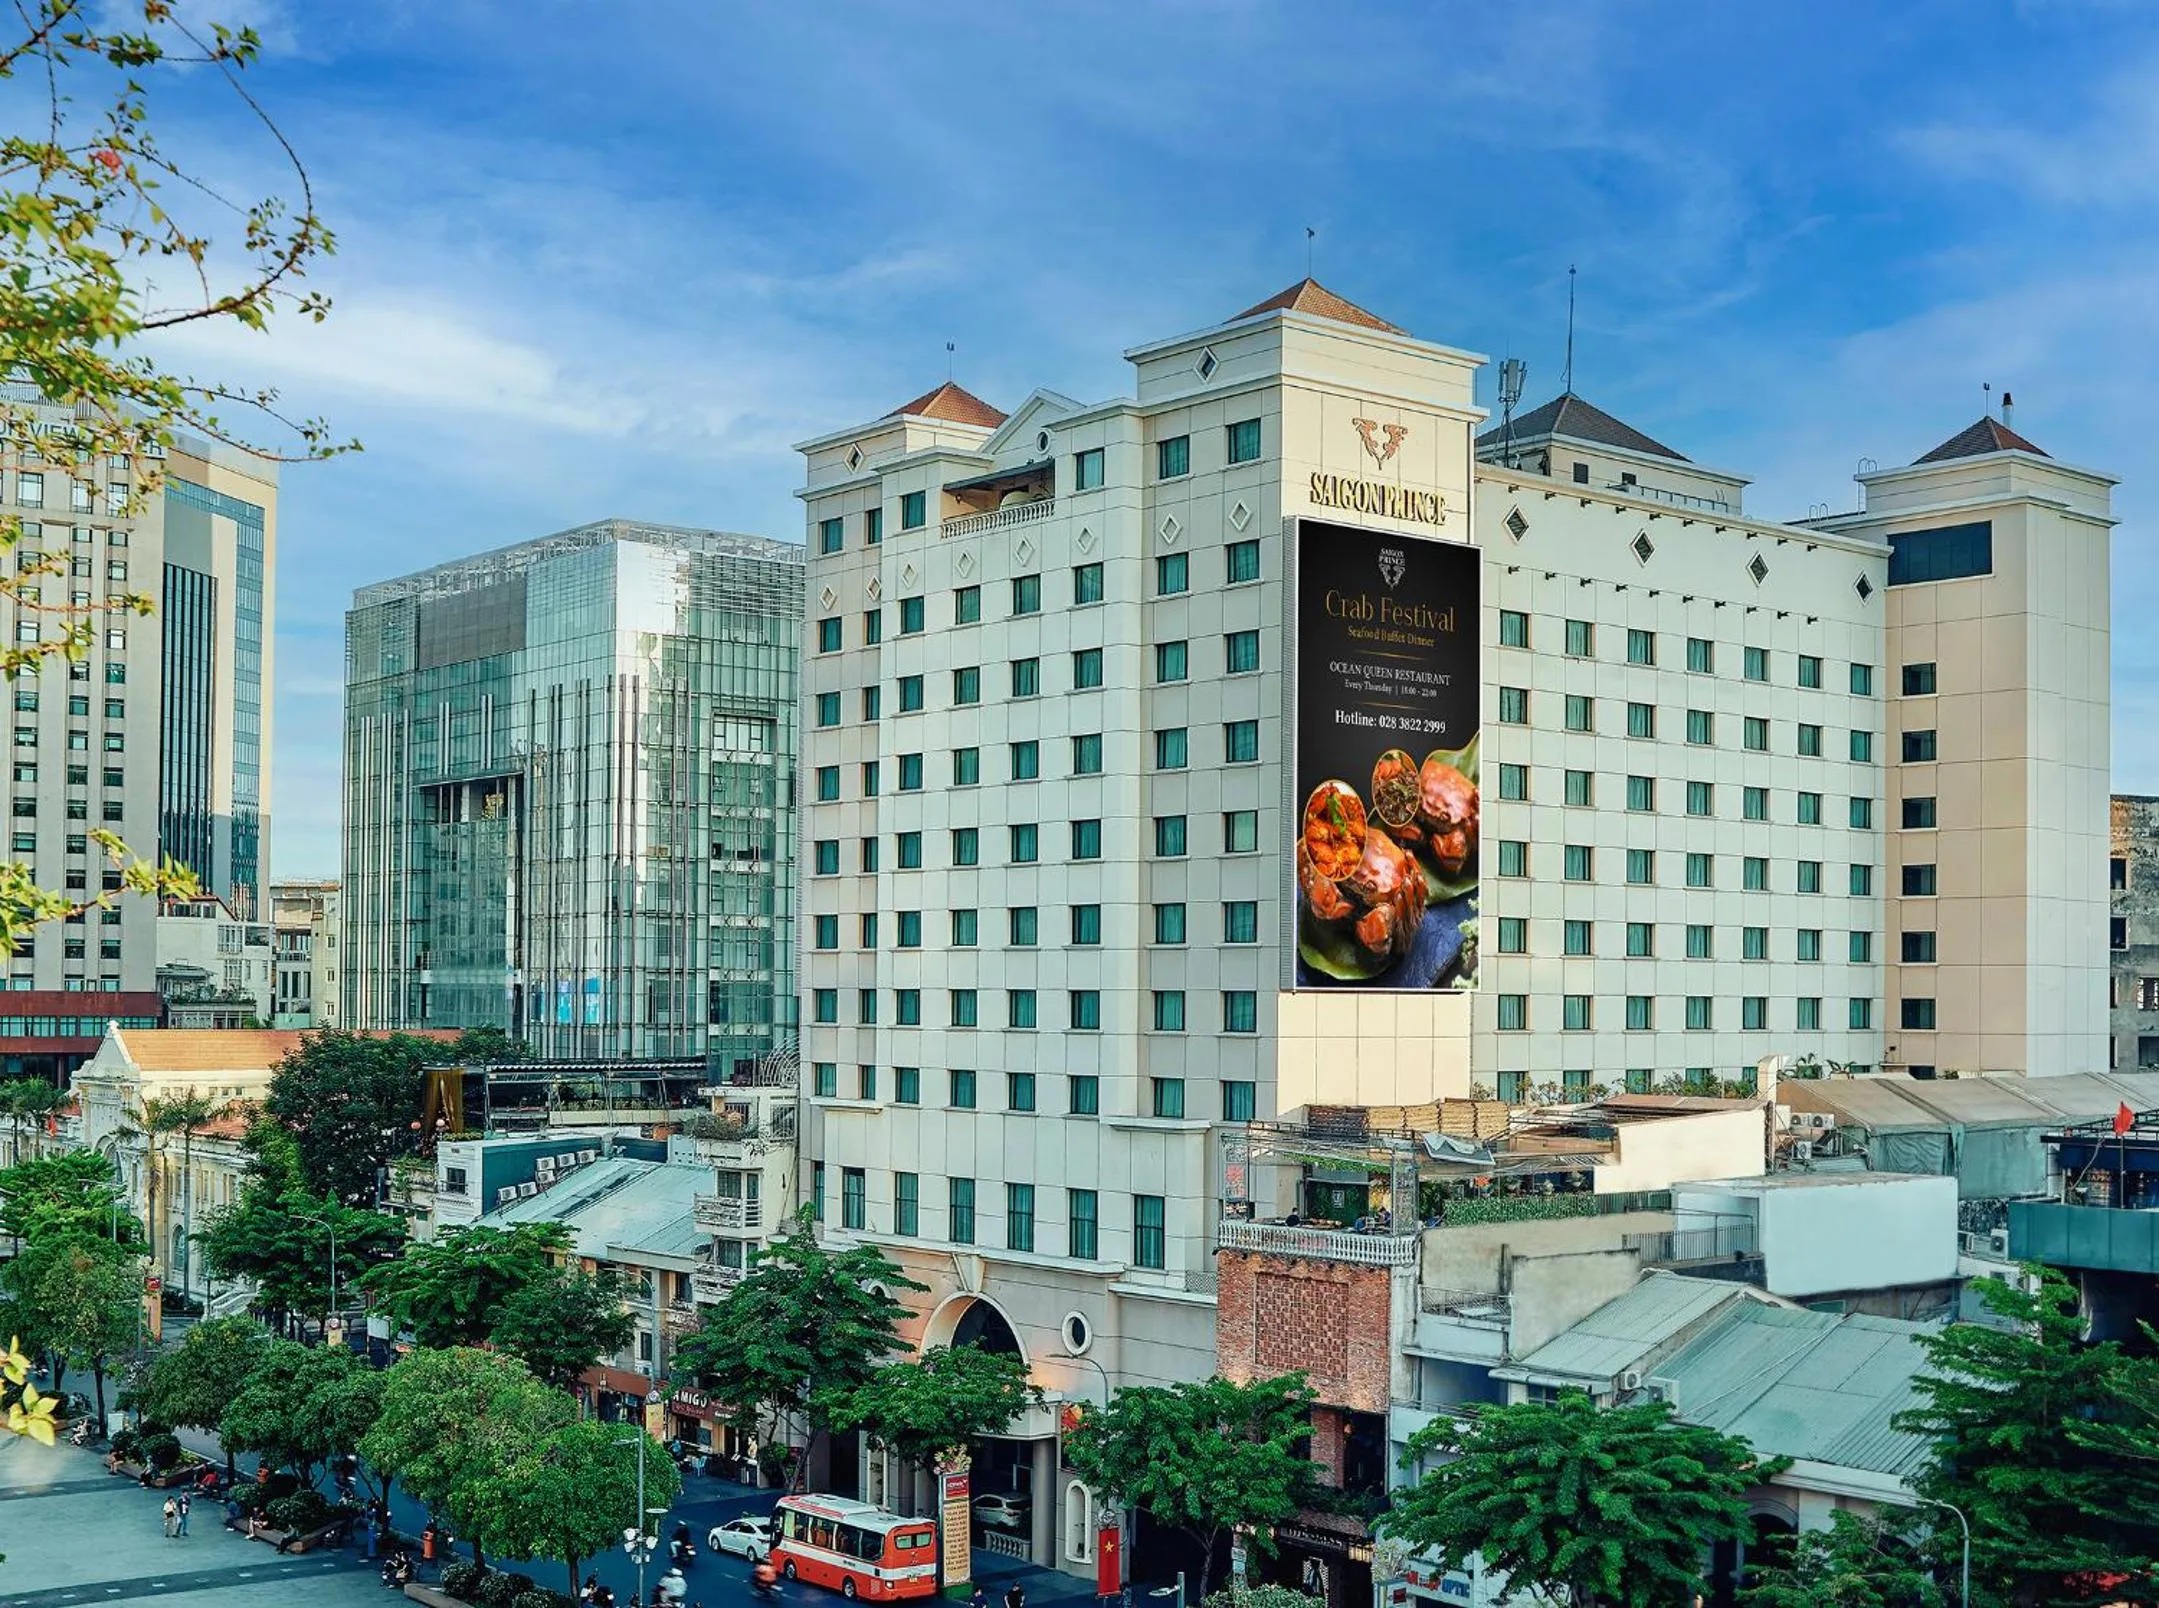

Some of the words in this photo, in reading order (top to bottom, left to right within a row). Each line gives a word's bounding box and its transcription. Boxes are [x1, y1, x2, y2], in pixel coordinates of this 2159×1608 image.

[1310, 472, 1381, 514] SAIGON
[1380, 484, 1446, 526] PRINCE
[1378, 556, 1406, 566] PRINCE
[1326, 589, 1374, 622] Crab
[1381, 597, 1455, 633] Festival
[1348, 625, 1380, 641] Seafood
[1329, 660, 1362, 675] OCEAN
[1363, 665, 1393, 679] QUEEN
[1395, 668, 1451, 687] RESTAURANT
[1344, 679, 1362, 691] Every
[1363, 680, 1393, 696] Thursday
[1335, 709, 1377, 727] Hotline:
[1379, 714, 1397, 730] 028
[1399, 717, 1422, 732] 3822
[1424, 719, 1446, 734] 2999
